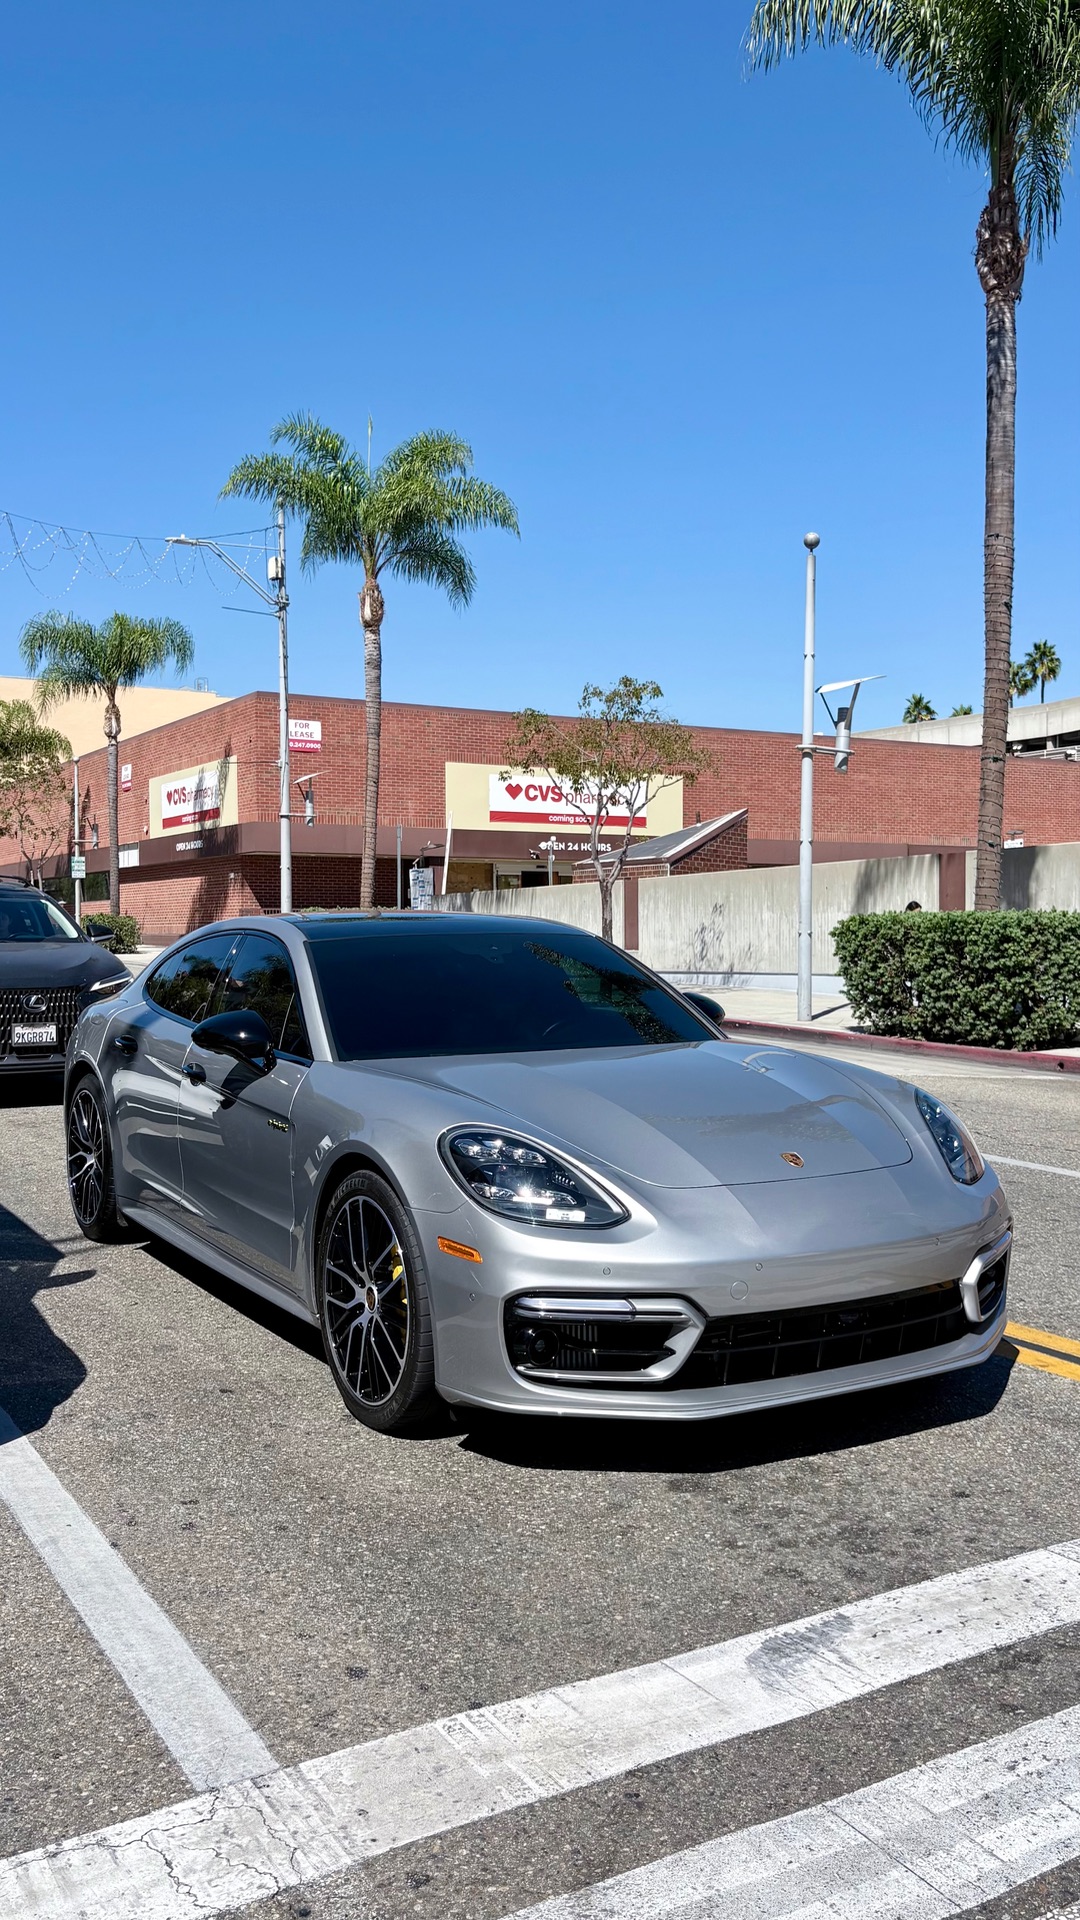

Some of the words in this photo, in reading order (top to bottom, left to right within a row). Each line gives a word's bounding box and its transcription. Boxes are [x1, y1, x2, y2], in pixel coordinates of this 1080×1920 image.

[294, 721, 310, 729] FOR
[289, 730, 315, 739] LEASE
[289, 741, 321, 749] 0.247.0900
[173, 786, 186, 805] CVS
[187, 785, 214, 805] pharmacy
[524, 784, 563, 803] CVS
[548, 815, 574, 824] coming
[567, 842, 579, 851] 24
[15, 1031, 55, 1043] 9KGR874
